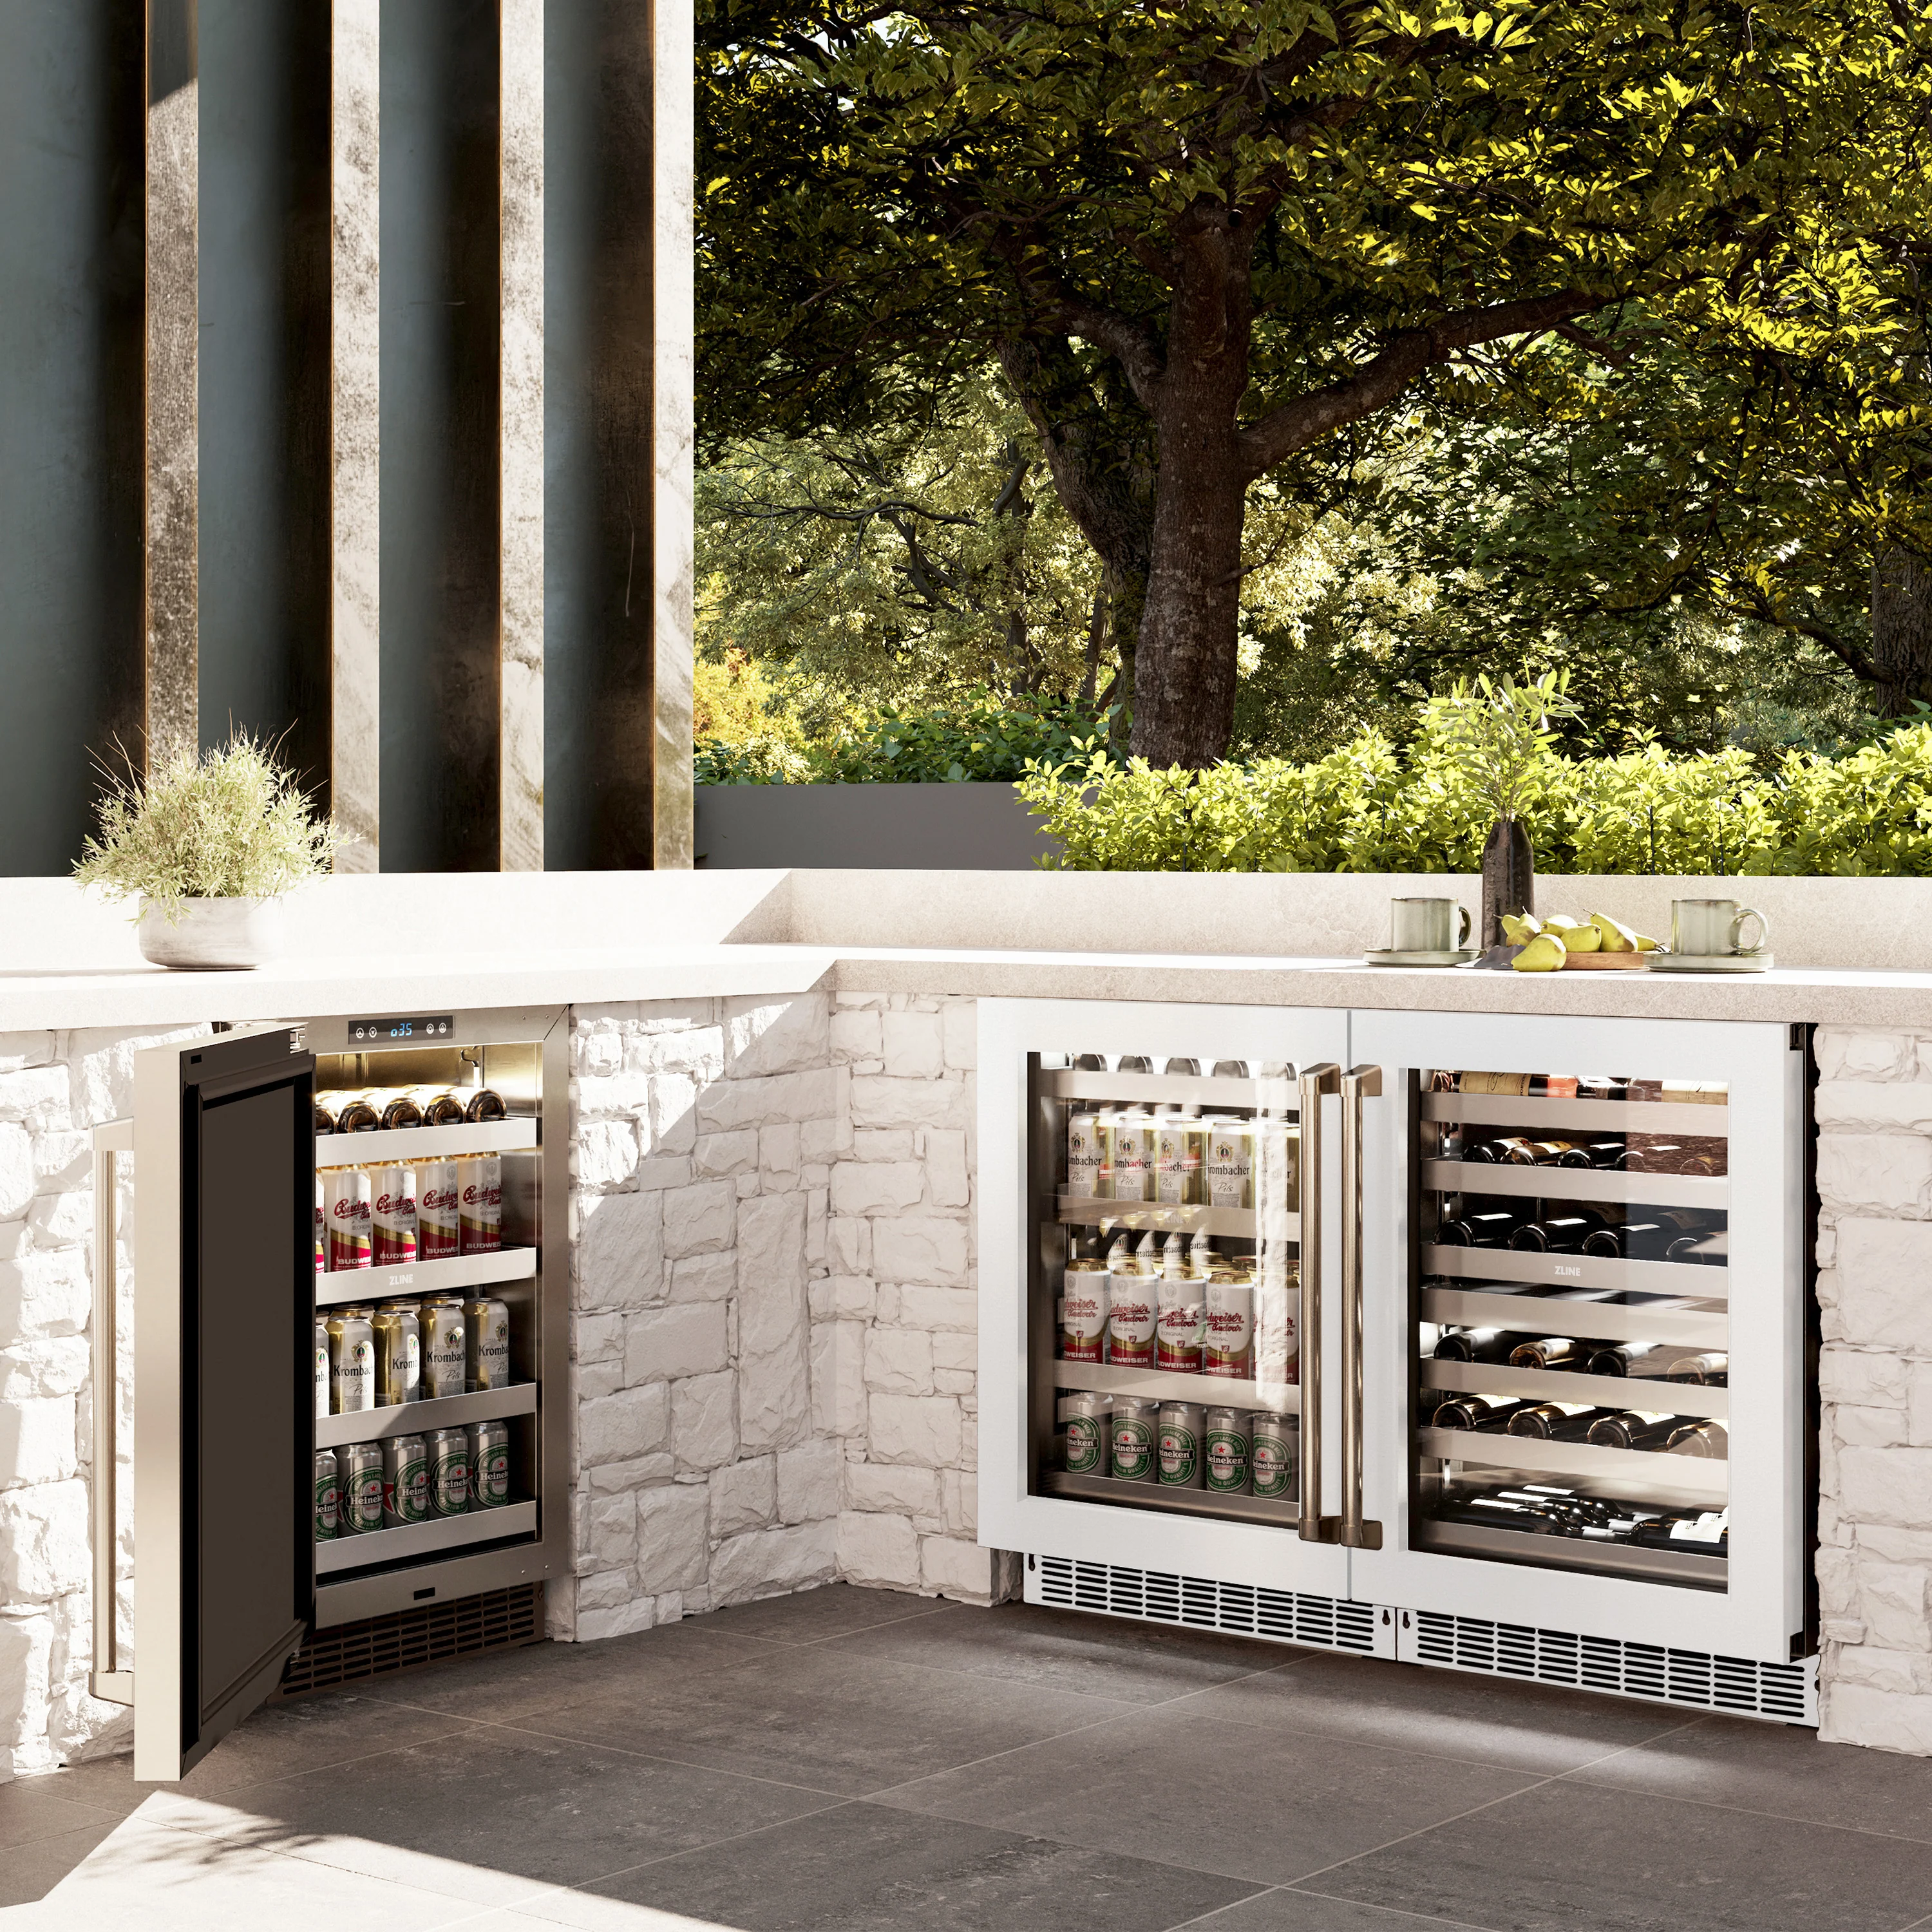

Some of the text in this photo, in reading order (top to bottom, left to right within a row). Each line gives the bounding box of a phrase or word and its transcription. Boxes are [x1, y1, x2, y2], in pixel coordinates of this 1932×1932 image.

[1070, 1172, 1084, 1182] Pils
[1119, 1175, 1135, 1186] Pils
[1161, 1178, 1173, 1188] Pils
[1215, 1182, 1234, 1193] Pils
[1554, 1265, 1581, 1276] ZLINE
[389, 1274, 413, 1285] ZLINE
[1119, 1313, 1150, 1322] Budvar
[1166, 1317, 1198, 1327] Budvar
[1212, 1321, 1243, 1332] Budvar
[441, 1369, 461, 1381] Pils
[1206, 1365, 1242, 1374] WEISER
[1128, 1461, 1145, 1473] QUALITY
[1170, 1467, 1186, 1479] QUALITY
[1222, 1473, 1241, 1485] QUALITY
[1264, 1479, 1282, 1491] QUALITY
